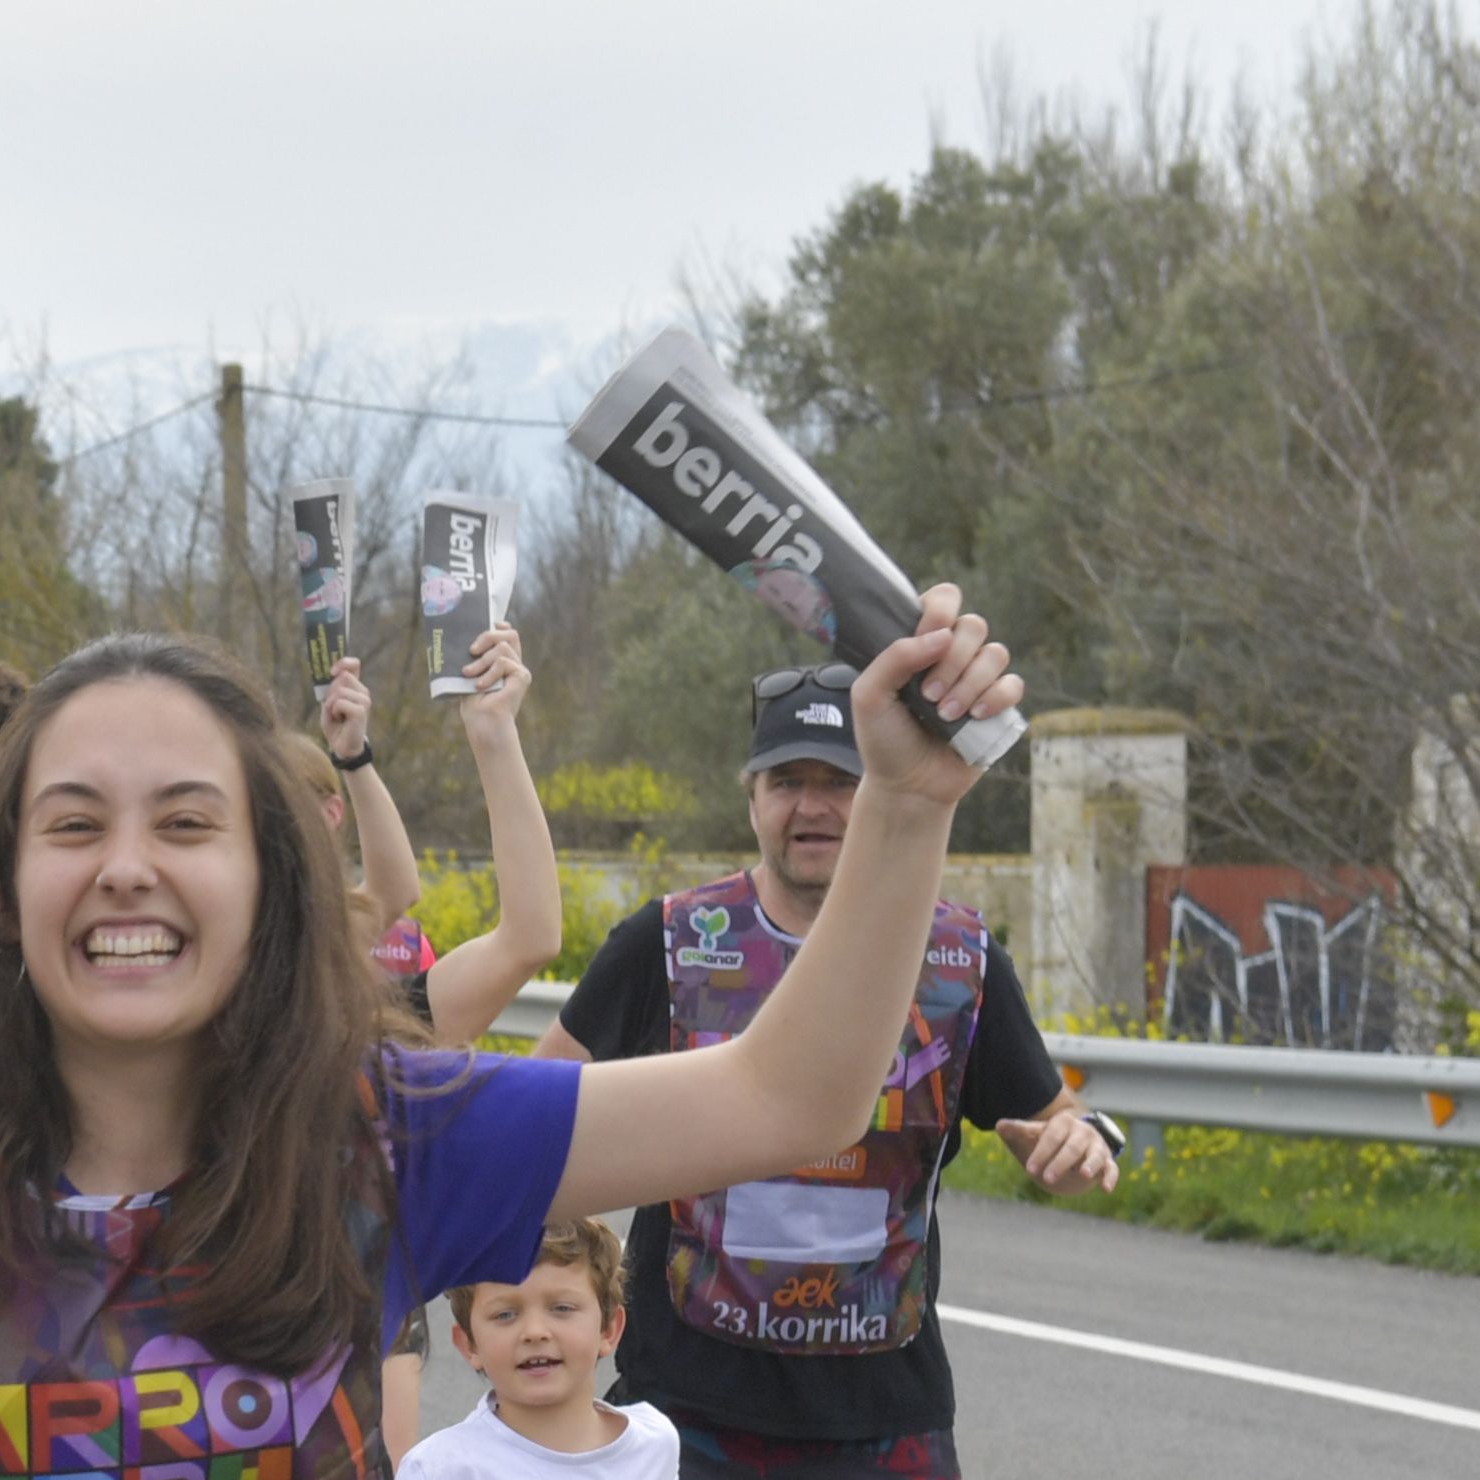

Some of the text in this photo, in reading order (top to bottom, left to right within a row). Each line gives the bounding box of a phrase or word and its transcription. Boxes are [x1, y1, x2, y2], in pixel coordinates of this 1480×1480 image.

[632, 401, 824, 575] berria
[449, 511, 484, 593] berria
[927, 945, 972, 968] eitb
[772, 1265, 840, 1309] aek
[711, 1299, 887, 1345] 23.korrika
